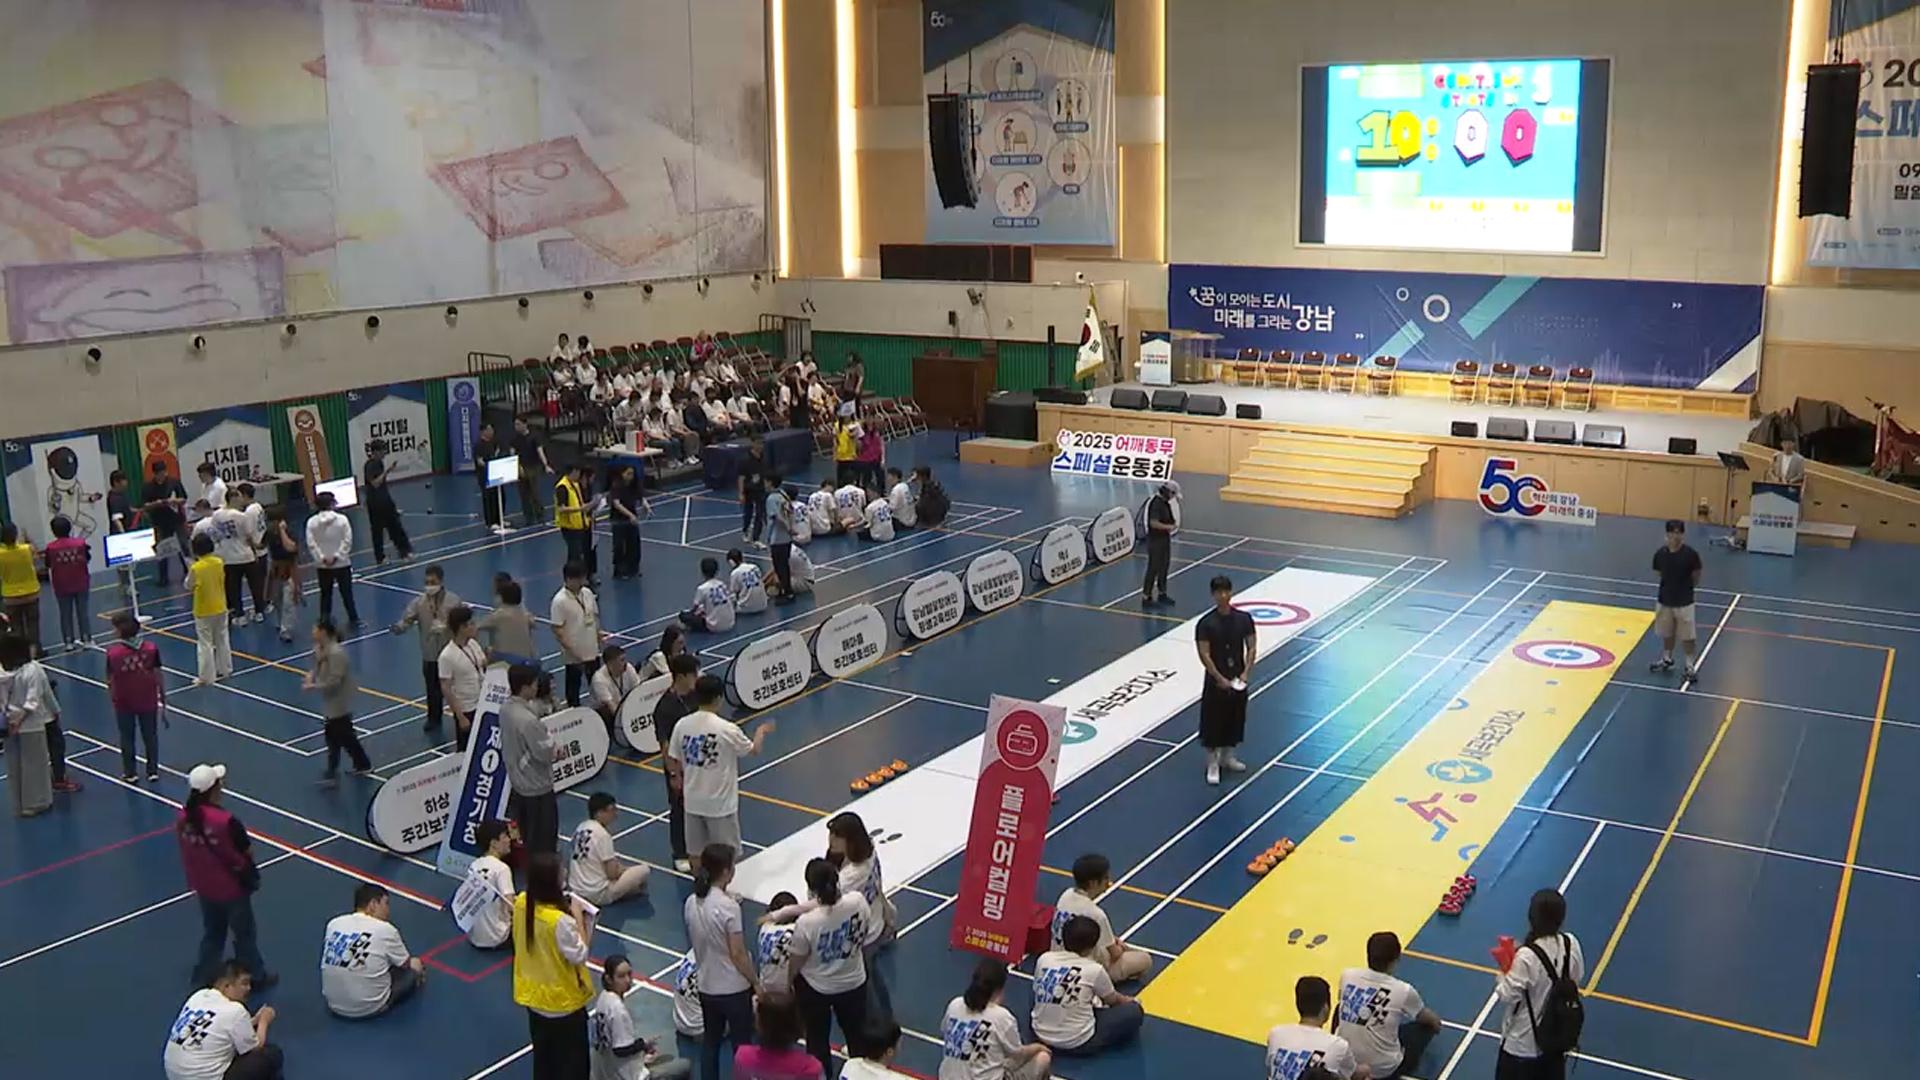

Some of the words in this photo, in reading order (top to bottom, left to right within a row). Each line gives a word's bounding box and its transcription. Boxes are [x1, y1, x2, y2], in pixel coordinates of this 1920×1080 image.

[1356, 109, 1538, 167] 10:00
[1200, 286, 1227, 307] 꿈이
[1229, 293, 1261, 308] 모이는
[1263, 293, 1290, 310] 도시
[1214, 308, 1255, 329] 미래를
[1257, 314, 1292, 330] 그리는
[1292, 304, 1336, 332] 강남
[370, 418, 408, 438] 디지털
[204, 444, 249, 465] 디지털
[1073, 433, 1113, 449] 2025
[1116, 436, 1173, 455] 어깨동무
[833, 642, 878, 669] 주간보호센터
[752, 671, 803, 702] 주간보호센터
[424, 792, 450, 814] 하상
